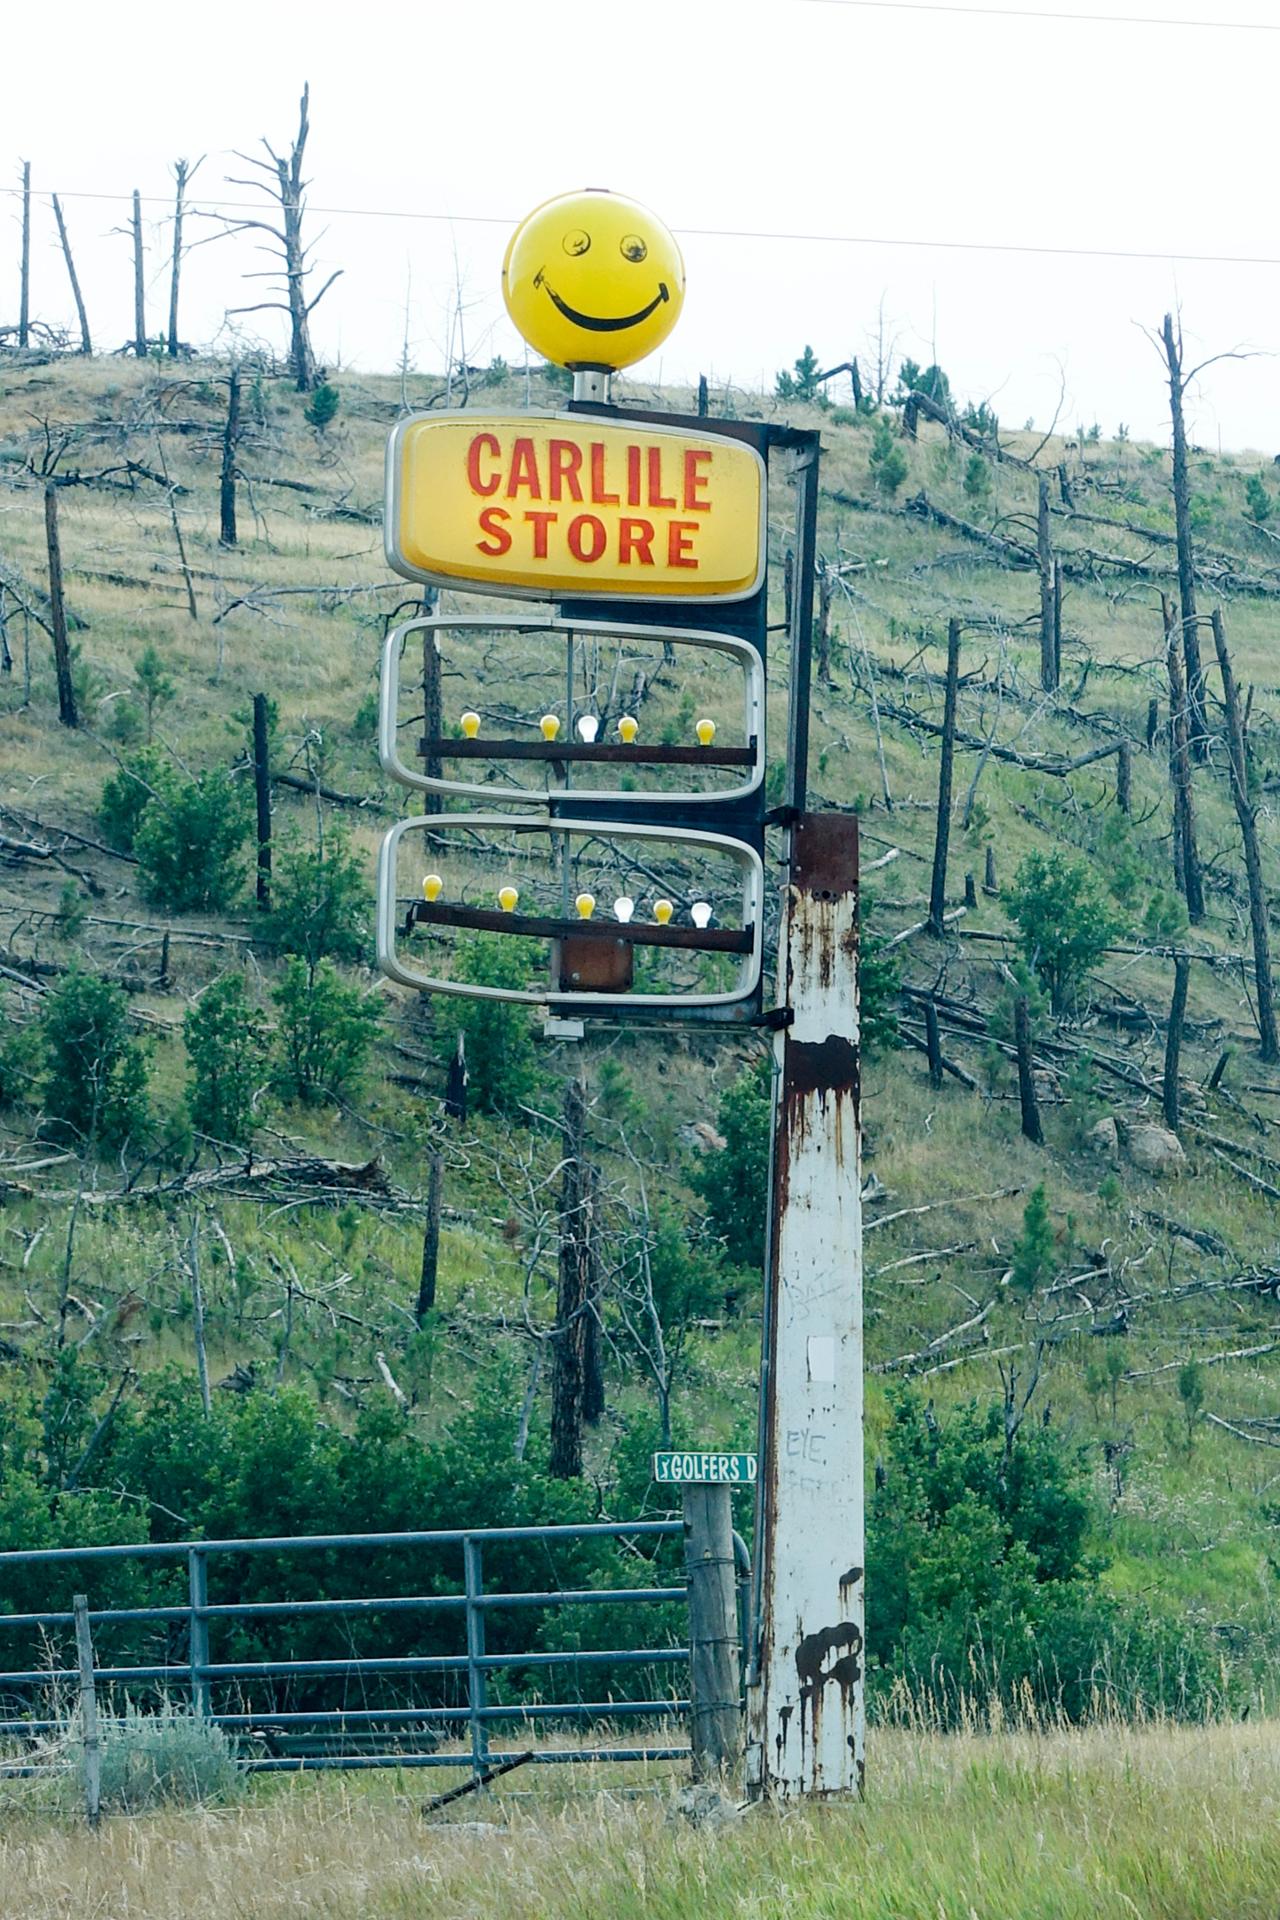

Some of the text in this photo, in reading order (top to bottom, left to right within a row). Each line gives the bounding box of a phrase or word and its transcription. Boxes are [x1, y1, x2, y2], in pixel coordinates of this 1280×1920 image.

[467, 432, 712, 511] CARLILE
[476, 507, 699, 569] STORE
[671, 1455, 740, 1480] GOLFERS
